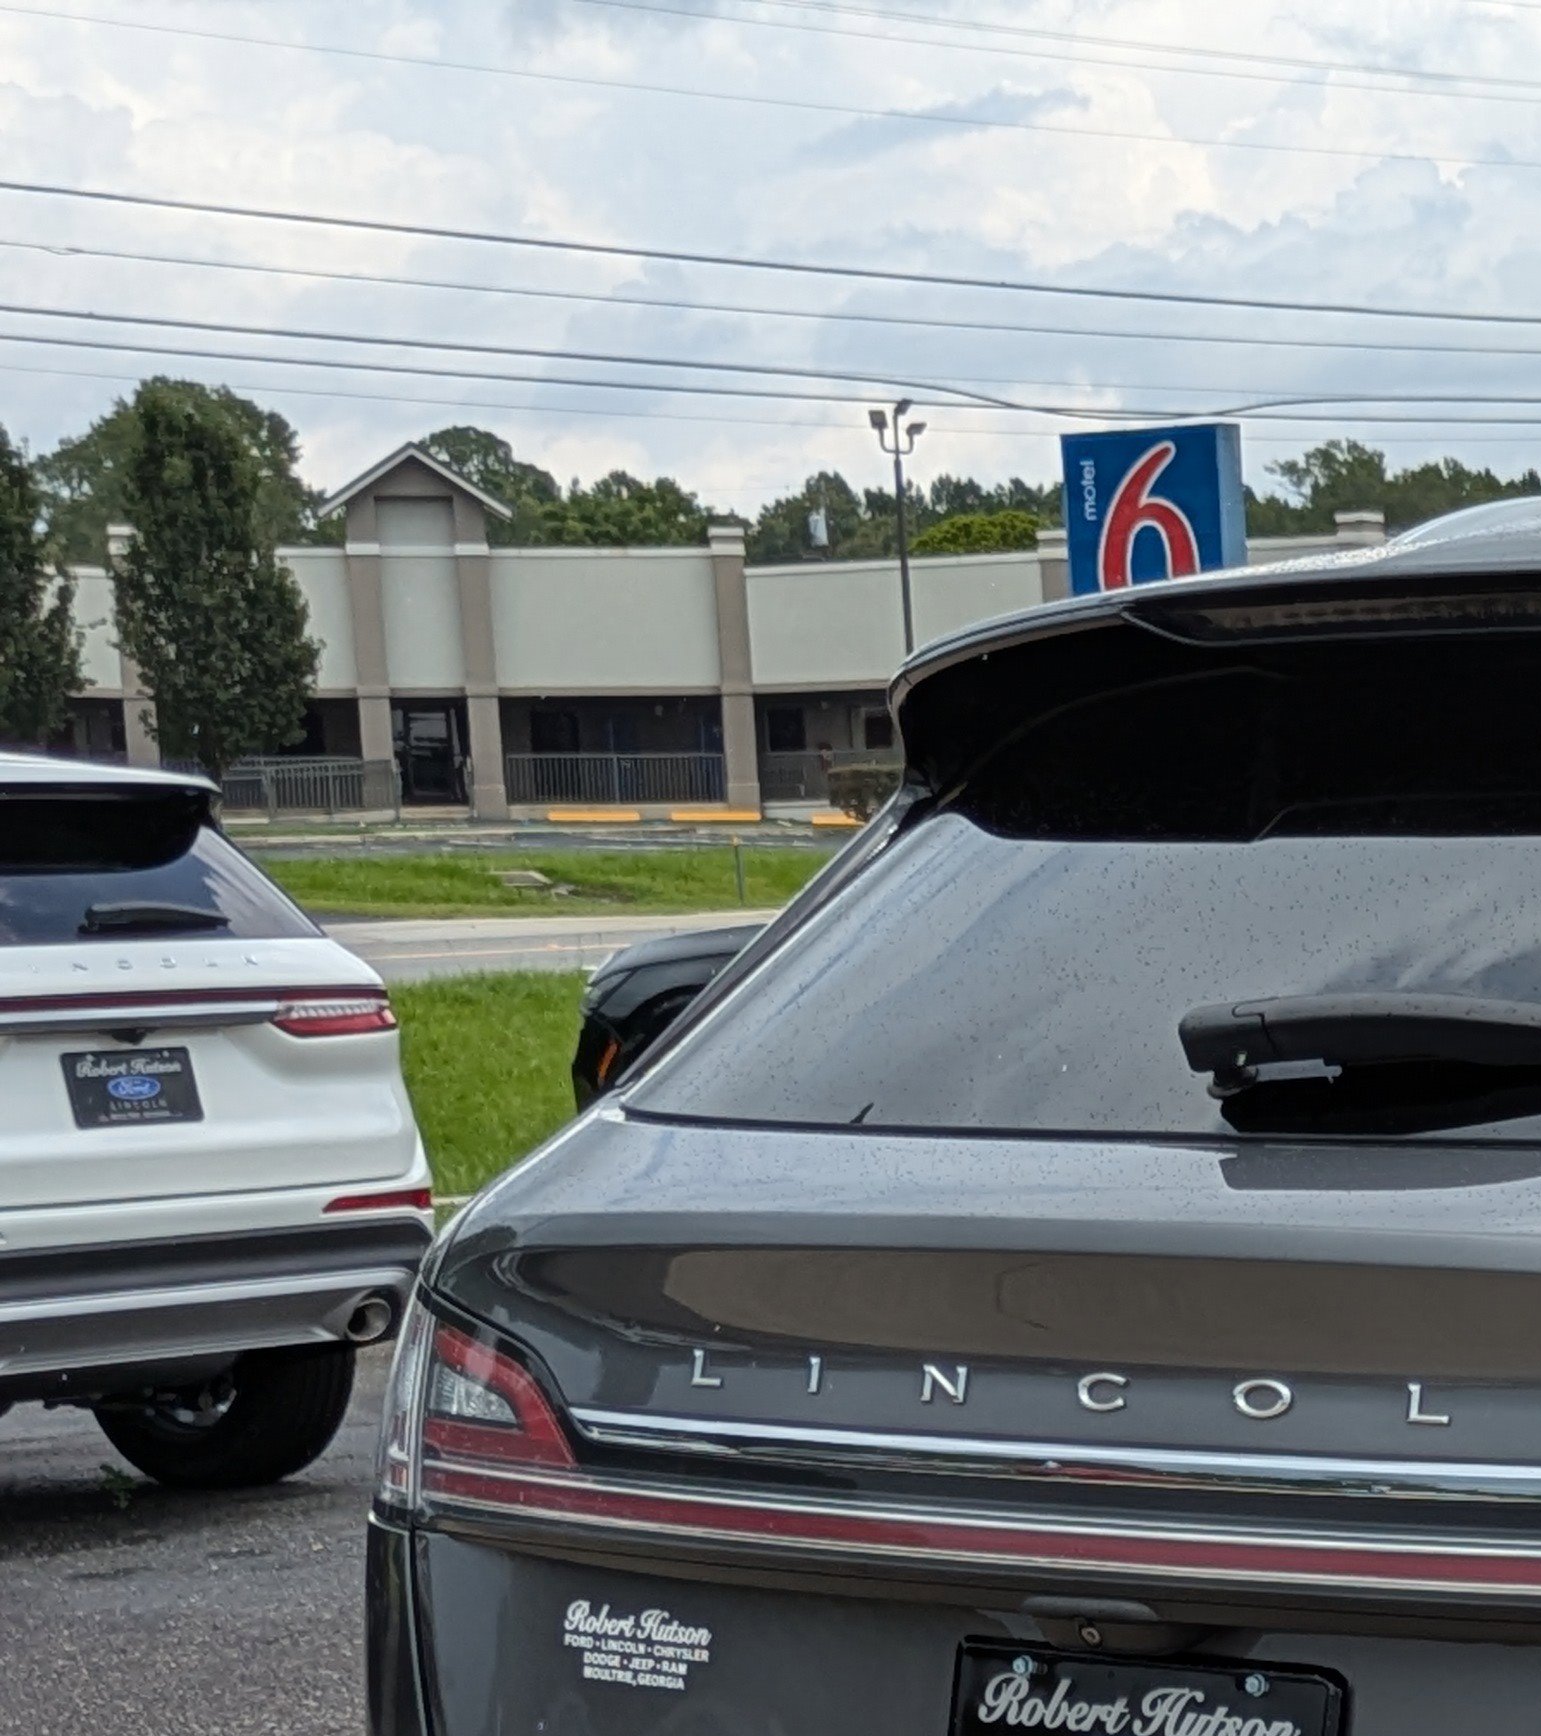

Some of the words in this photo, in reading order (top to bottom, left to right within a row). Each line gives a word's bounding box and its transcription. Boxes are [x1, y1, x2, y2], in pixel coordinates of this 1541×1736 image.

[1079, 459, 1097, 520] motel
[1097, 440, 1200, 591] 6
[563, 1600, 635, 1637] Robert
[636, 1609, 711, 1646] Hutson
[563, 1634, 593, 1648] FORD
[601, 1639, 645, 1654] LINCOLN
[653, 1646, 709, 1662] CHRYSLER
[583, 1652, 620, 1667] DODGE
[629, 1659, 654, 1670] JEEP
[661, 1662, 687, 1675] RAM
[637, 1673, 685, 1689] GEORGIA
[977, 1672, 1130, 1735] Robert
